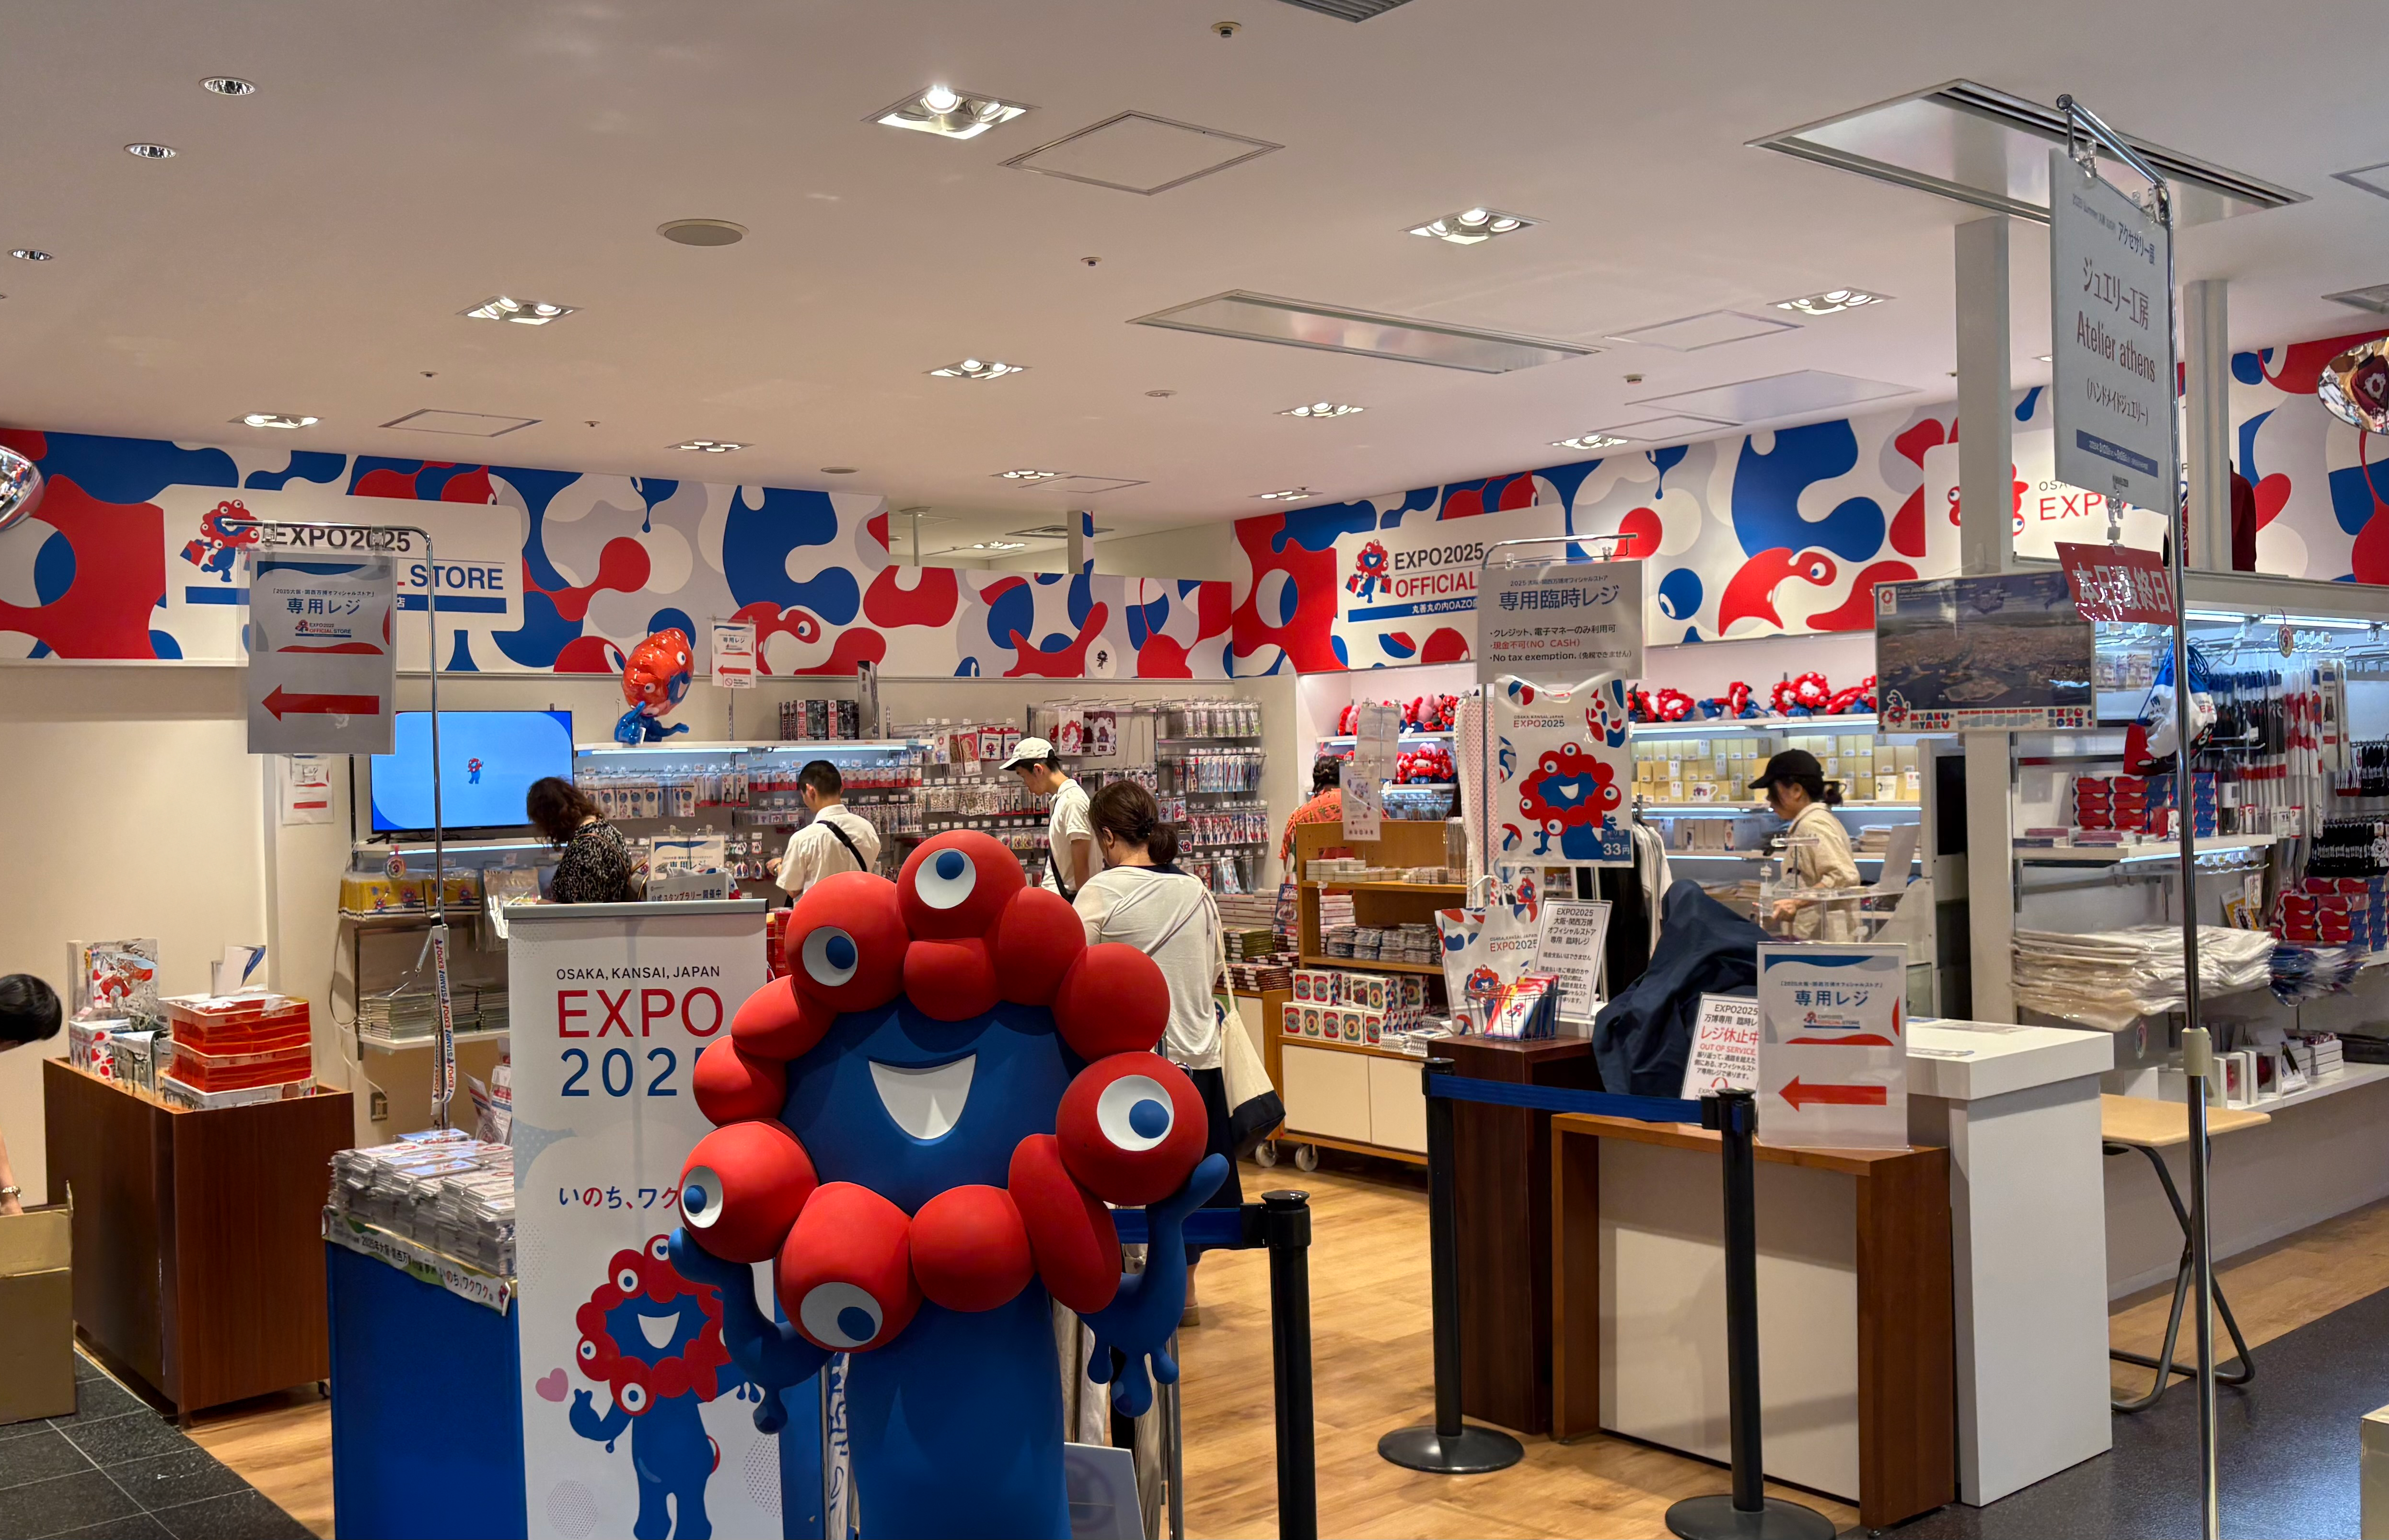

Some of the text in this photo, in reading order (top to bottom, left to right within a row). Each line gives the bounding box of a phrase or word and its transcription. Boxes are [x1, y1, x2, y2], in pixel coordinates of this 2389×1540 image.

[2083, 257, 2149, 330] ジュエリー工房
[2077, 311, 2156, 382] Atelier athens
[1395, 542, 1484, 570] EXPO2025
[410, 564, 504, 590] STORE
[1395, 571, 1478, 598] OFFICIAL
[2072, 562, 2172, 613] 本日最終日
[287, 598, 360, 615] 専用レジ
[1499, 585, 1619, 611] 専用臨時レジ
[1525, 651, 1577, 661] exemption.
[1513, 719, 1565, 728] EXPO2025
[1556, 908, 1593, 916] EXPO2025
[1547, 926, 1596, 936] オフィシャルストア
[557, 965, 720, 981] OSAKA, KANSAI, JAPAN
[1795, 990, 1868, 1007] 専用レジ
[557, 986, 724, 1038] EXPO
[1705, 1014, 1732, 1024] 万博専用
[1715, 1004, 1759, 1016] EXPO2025
[1701, 1025, 1759, 1045] レジ休止中
[1727, 1046, 1756, 1055] SERVICE
[560, 1047, 705, 1097] 202
